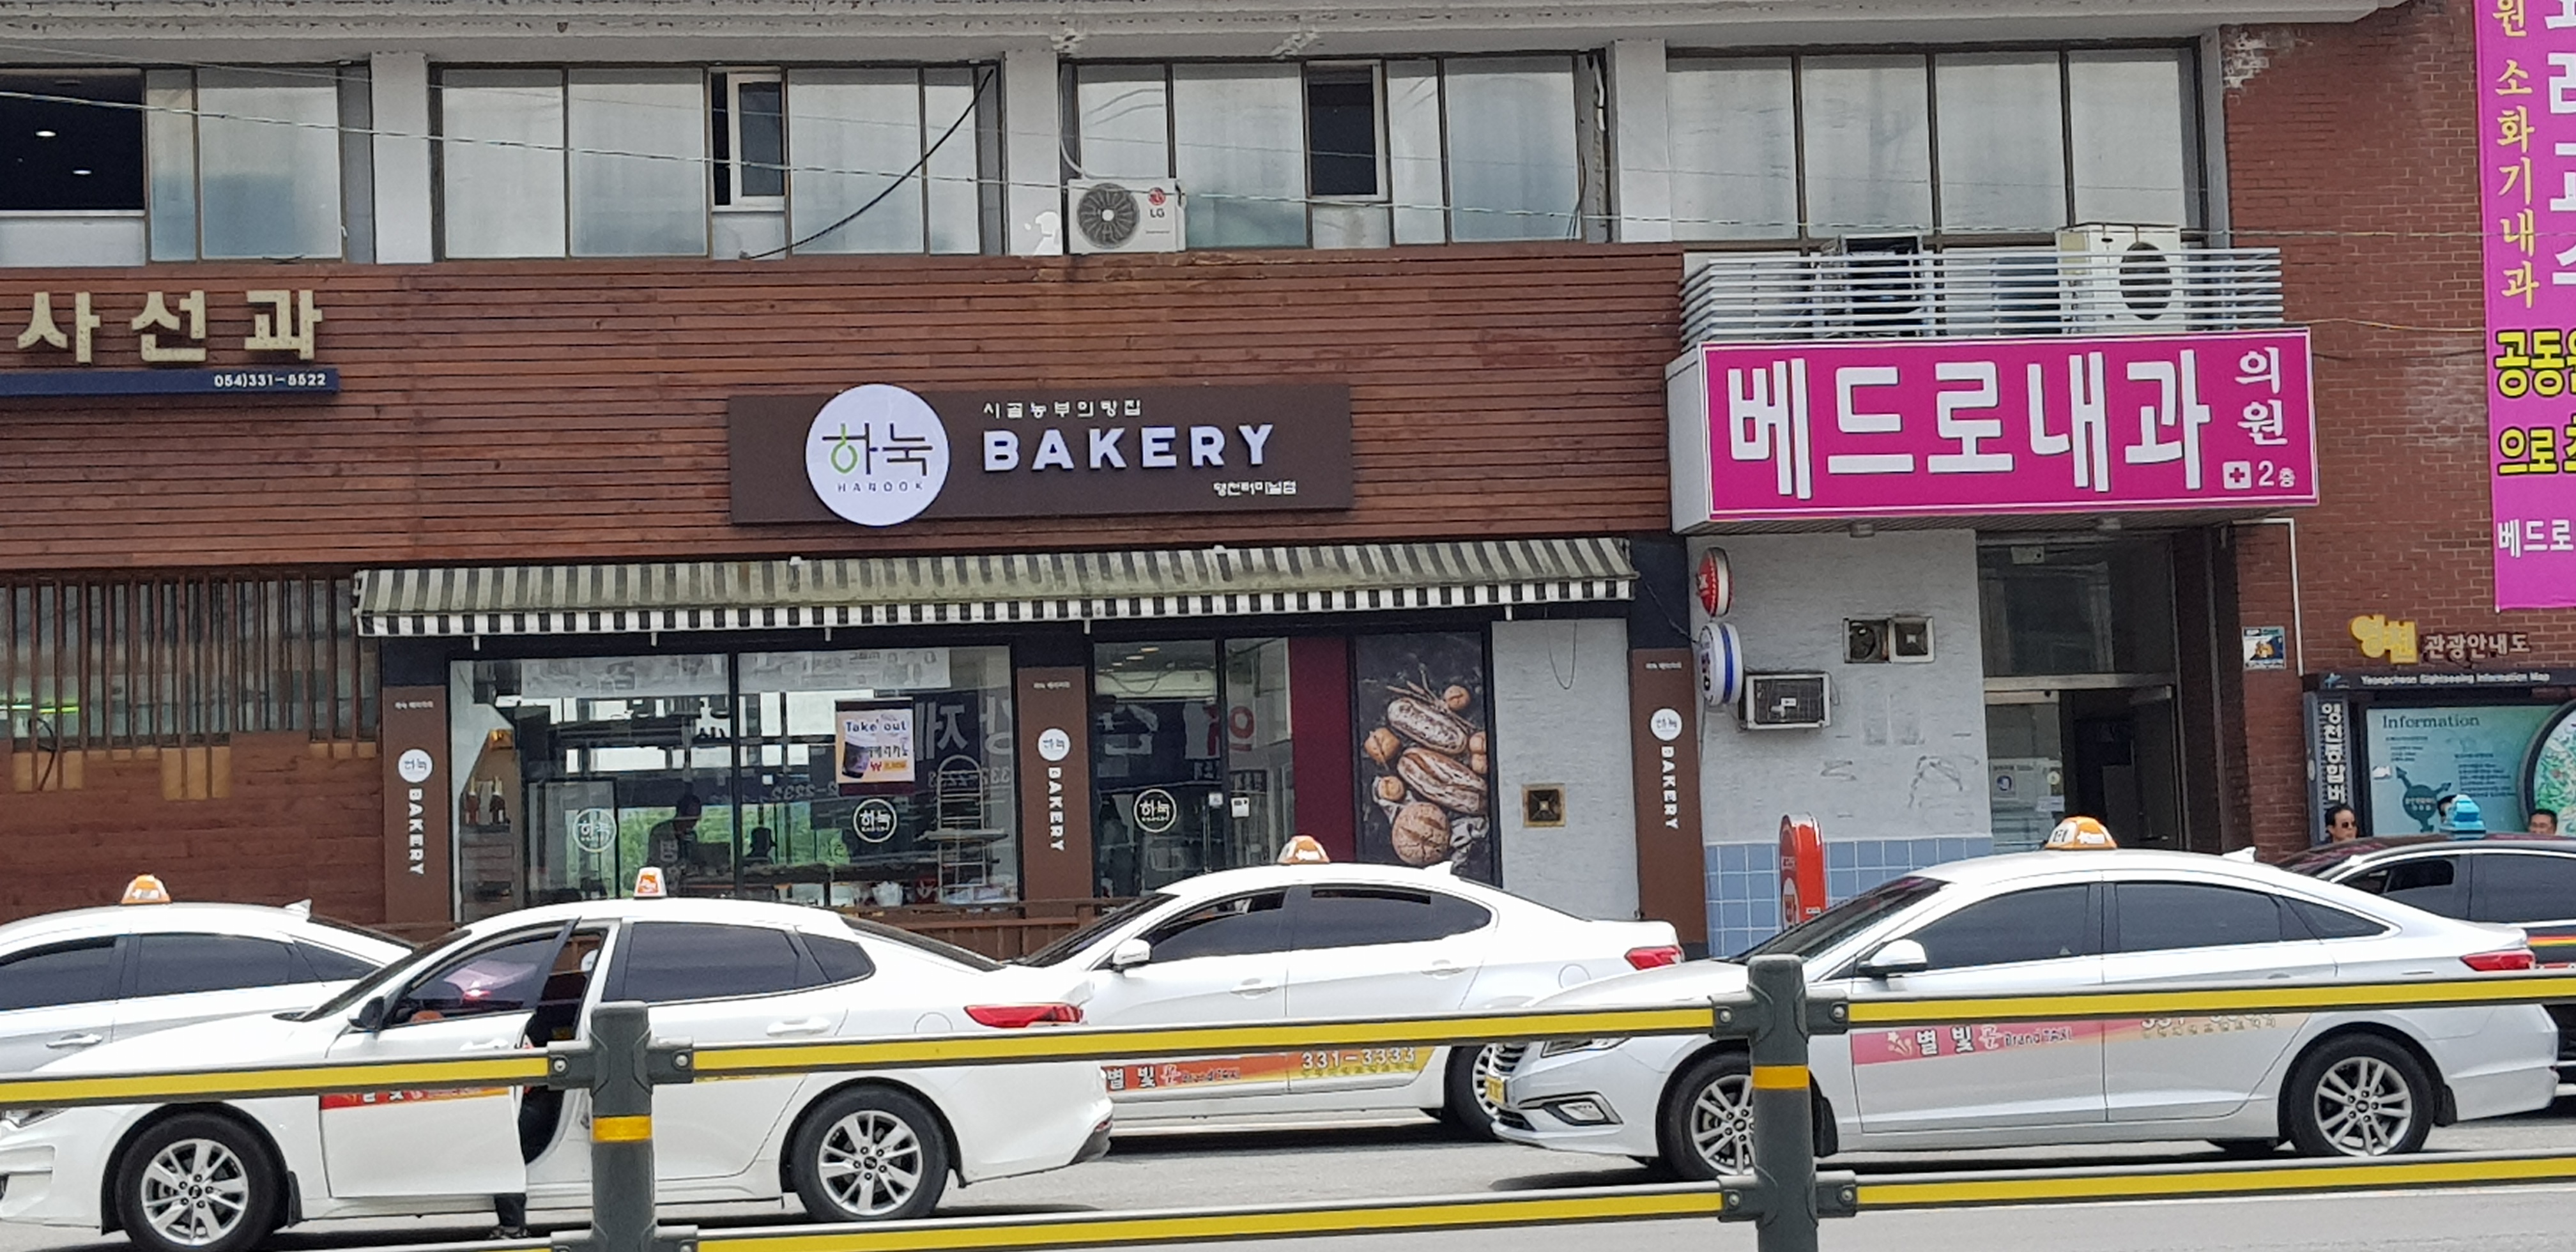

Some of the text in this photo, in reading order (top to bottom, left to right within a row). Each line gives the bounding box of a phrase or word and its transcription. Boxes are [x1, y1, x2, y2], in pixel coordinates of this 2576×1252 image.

[1149, 208, 1165, 218] LG
[2495, 59, 2540, 309] 소화기내과
[1727, 349, 2211, 500] 베드로내과
[2235, 347, 2288, 445] 의원
[822, 422, 933, 477] 하눅
[983, 424, 1275, 472] BAKERY
[2425, 633, 2531, 660] 관광안내도
[2382, 714, 2480, 729] Information
[1048, 767, 1064, 851] BAKERY
[1661, 746, 1678, 829] BAKERY
[409, 788, 424, 874] BAKERY
